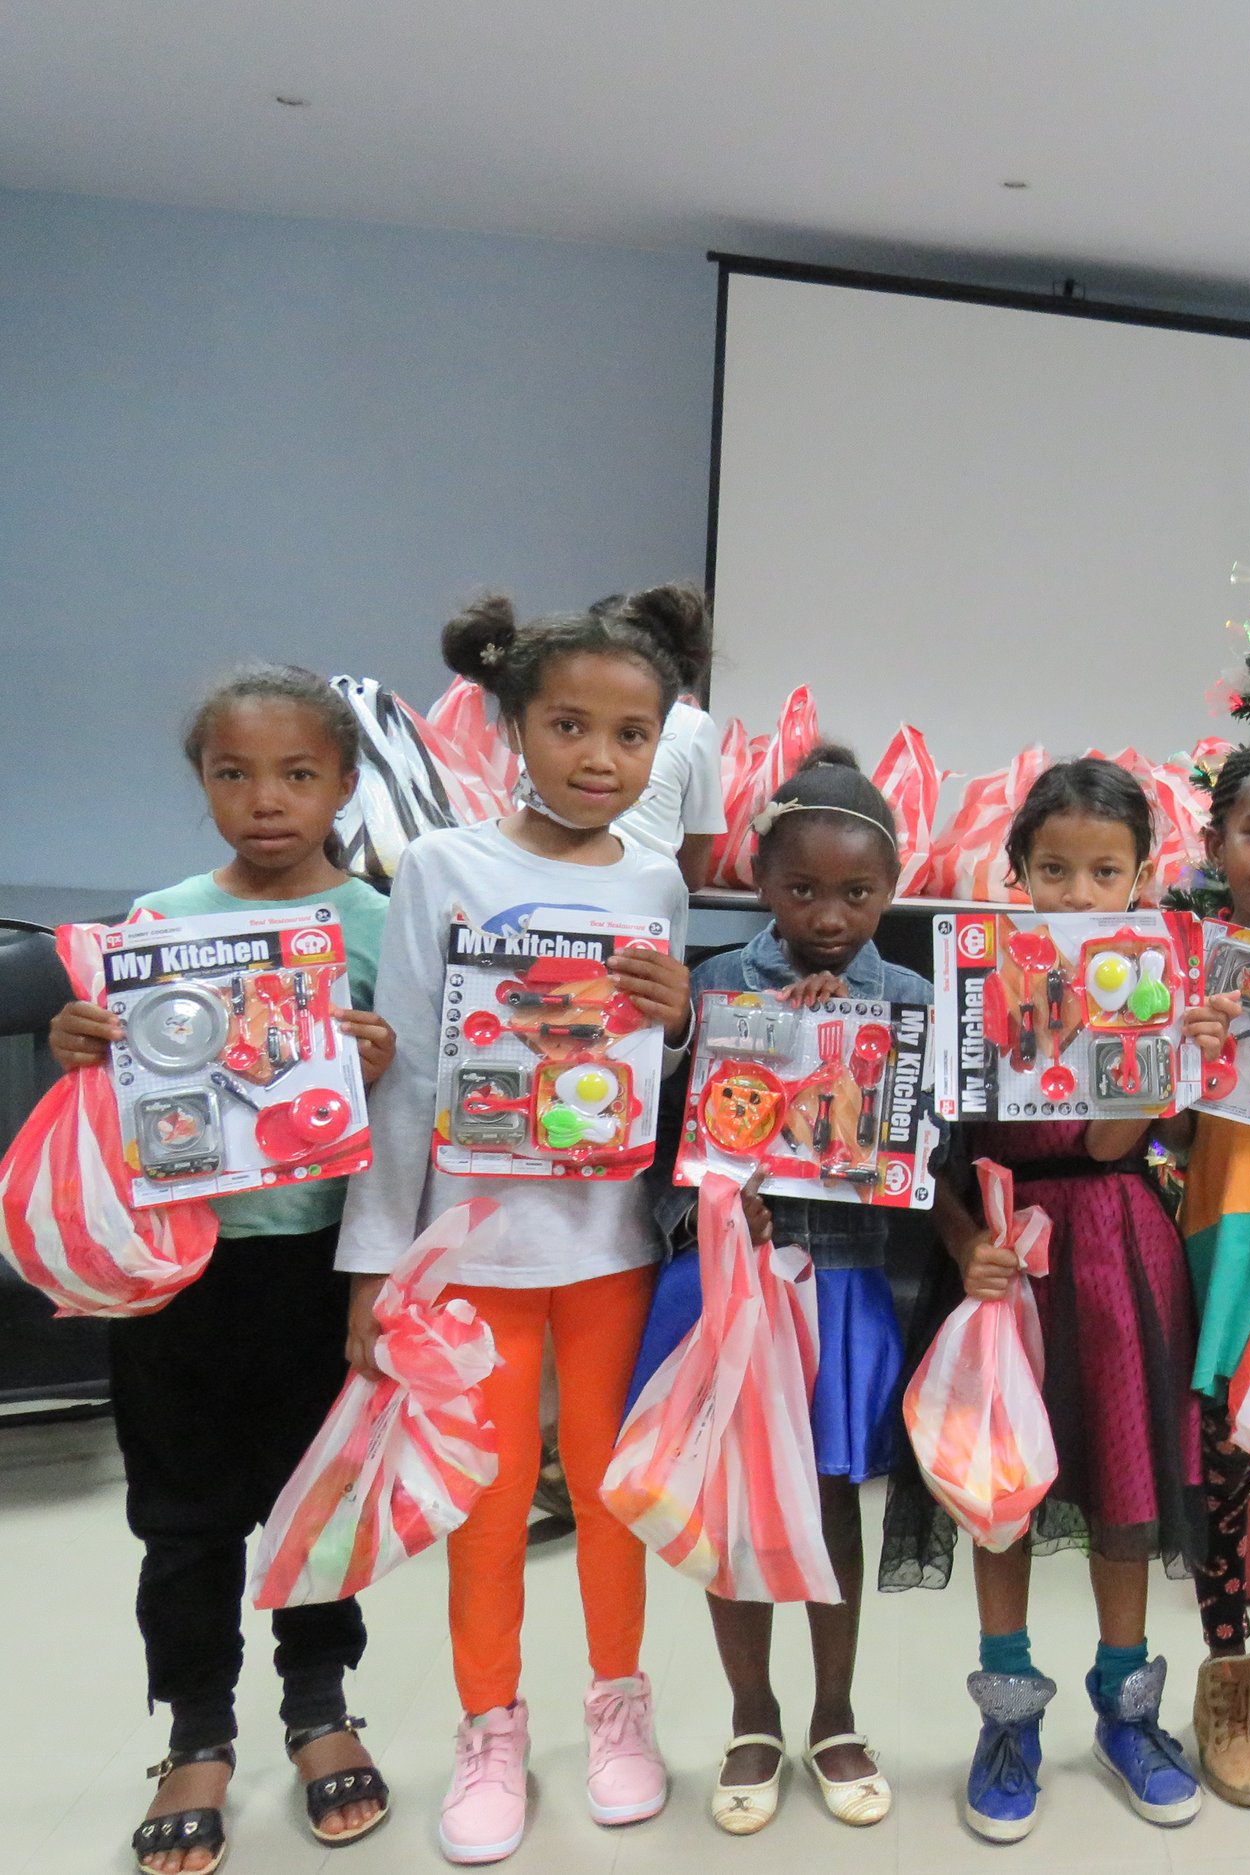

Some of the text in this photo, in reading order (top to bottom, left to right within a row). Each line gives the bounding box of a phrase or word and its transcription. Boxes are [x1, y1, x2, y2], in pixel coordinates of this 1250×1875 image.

[111, 953, 152, 981] My
[160, 939, 270, 973] Kitchen
[456, 928, 603, 961] My Kitchen
[891, 1009, 925, 1142] My Kitchen
[961, 977, 986, 1113] My Kitchen
